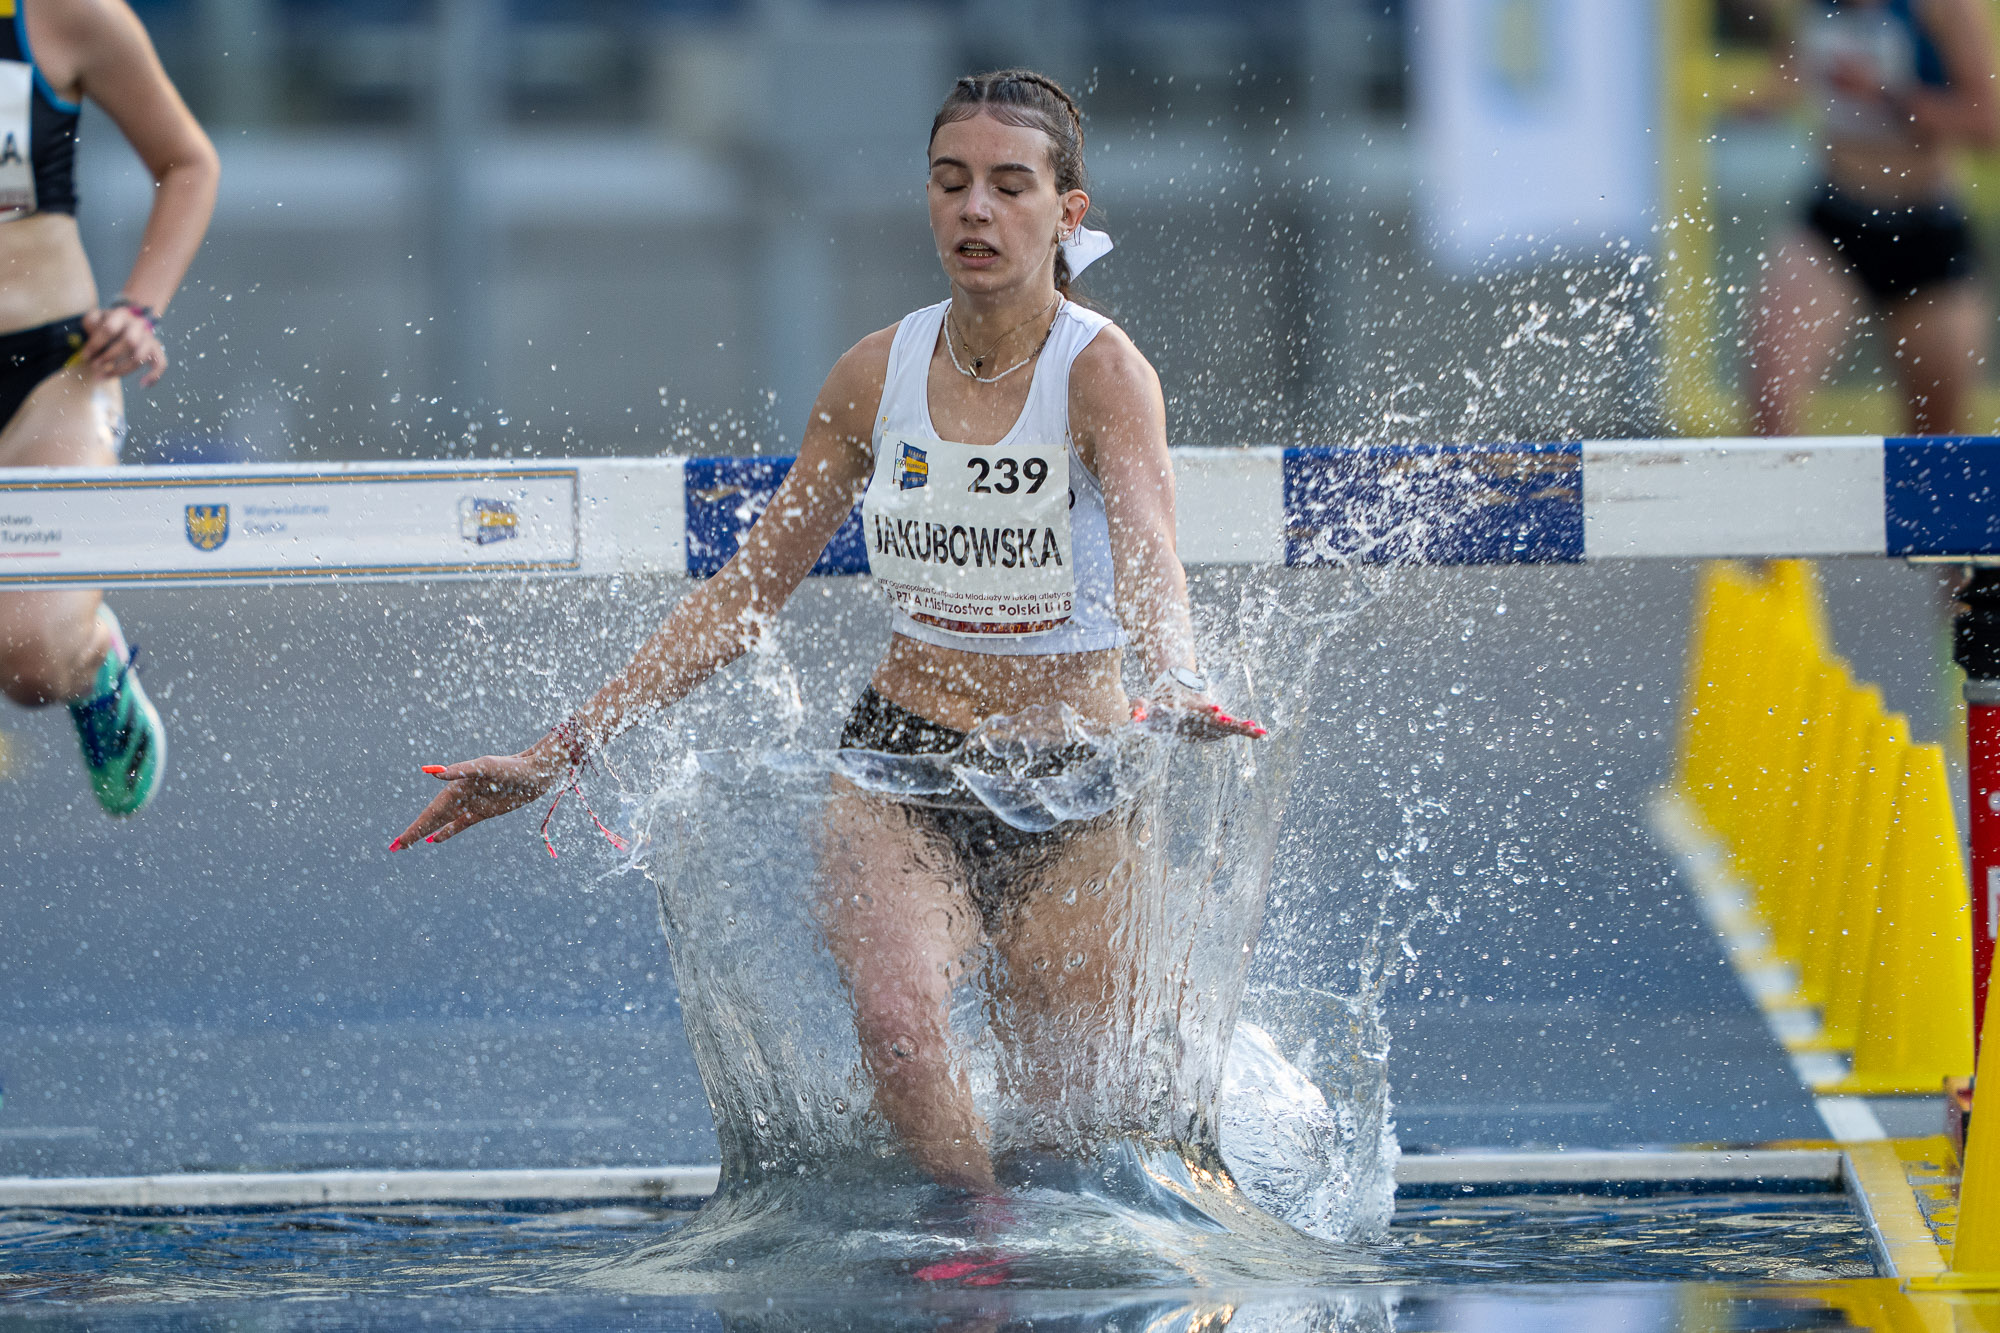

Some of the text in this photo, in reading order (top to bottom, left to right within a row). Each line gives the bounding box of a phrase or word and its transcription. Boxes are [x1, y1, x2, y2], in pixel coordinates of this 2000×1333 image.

[967, 457, 1048, 494] 239
[874, 514, 1063, 568] JAKUBOWSKA
[924, 596, 994, 616] Mistrzostwa
[998, 602, 1040, 616] Polski
[1044, 600, 1072, 614] U18
